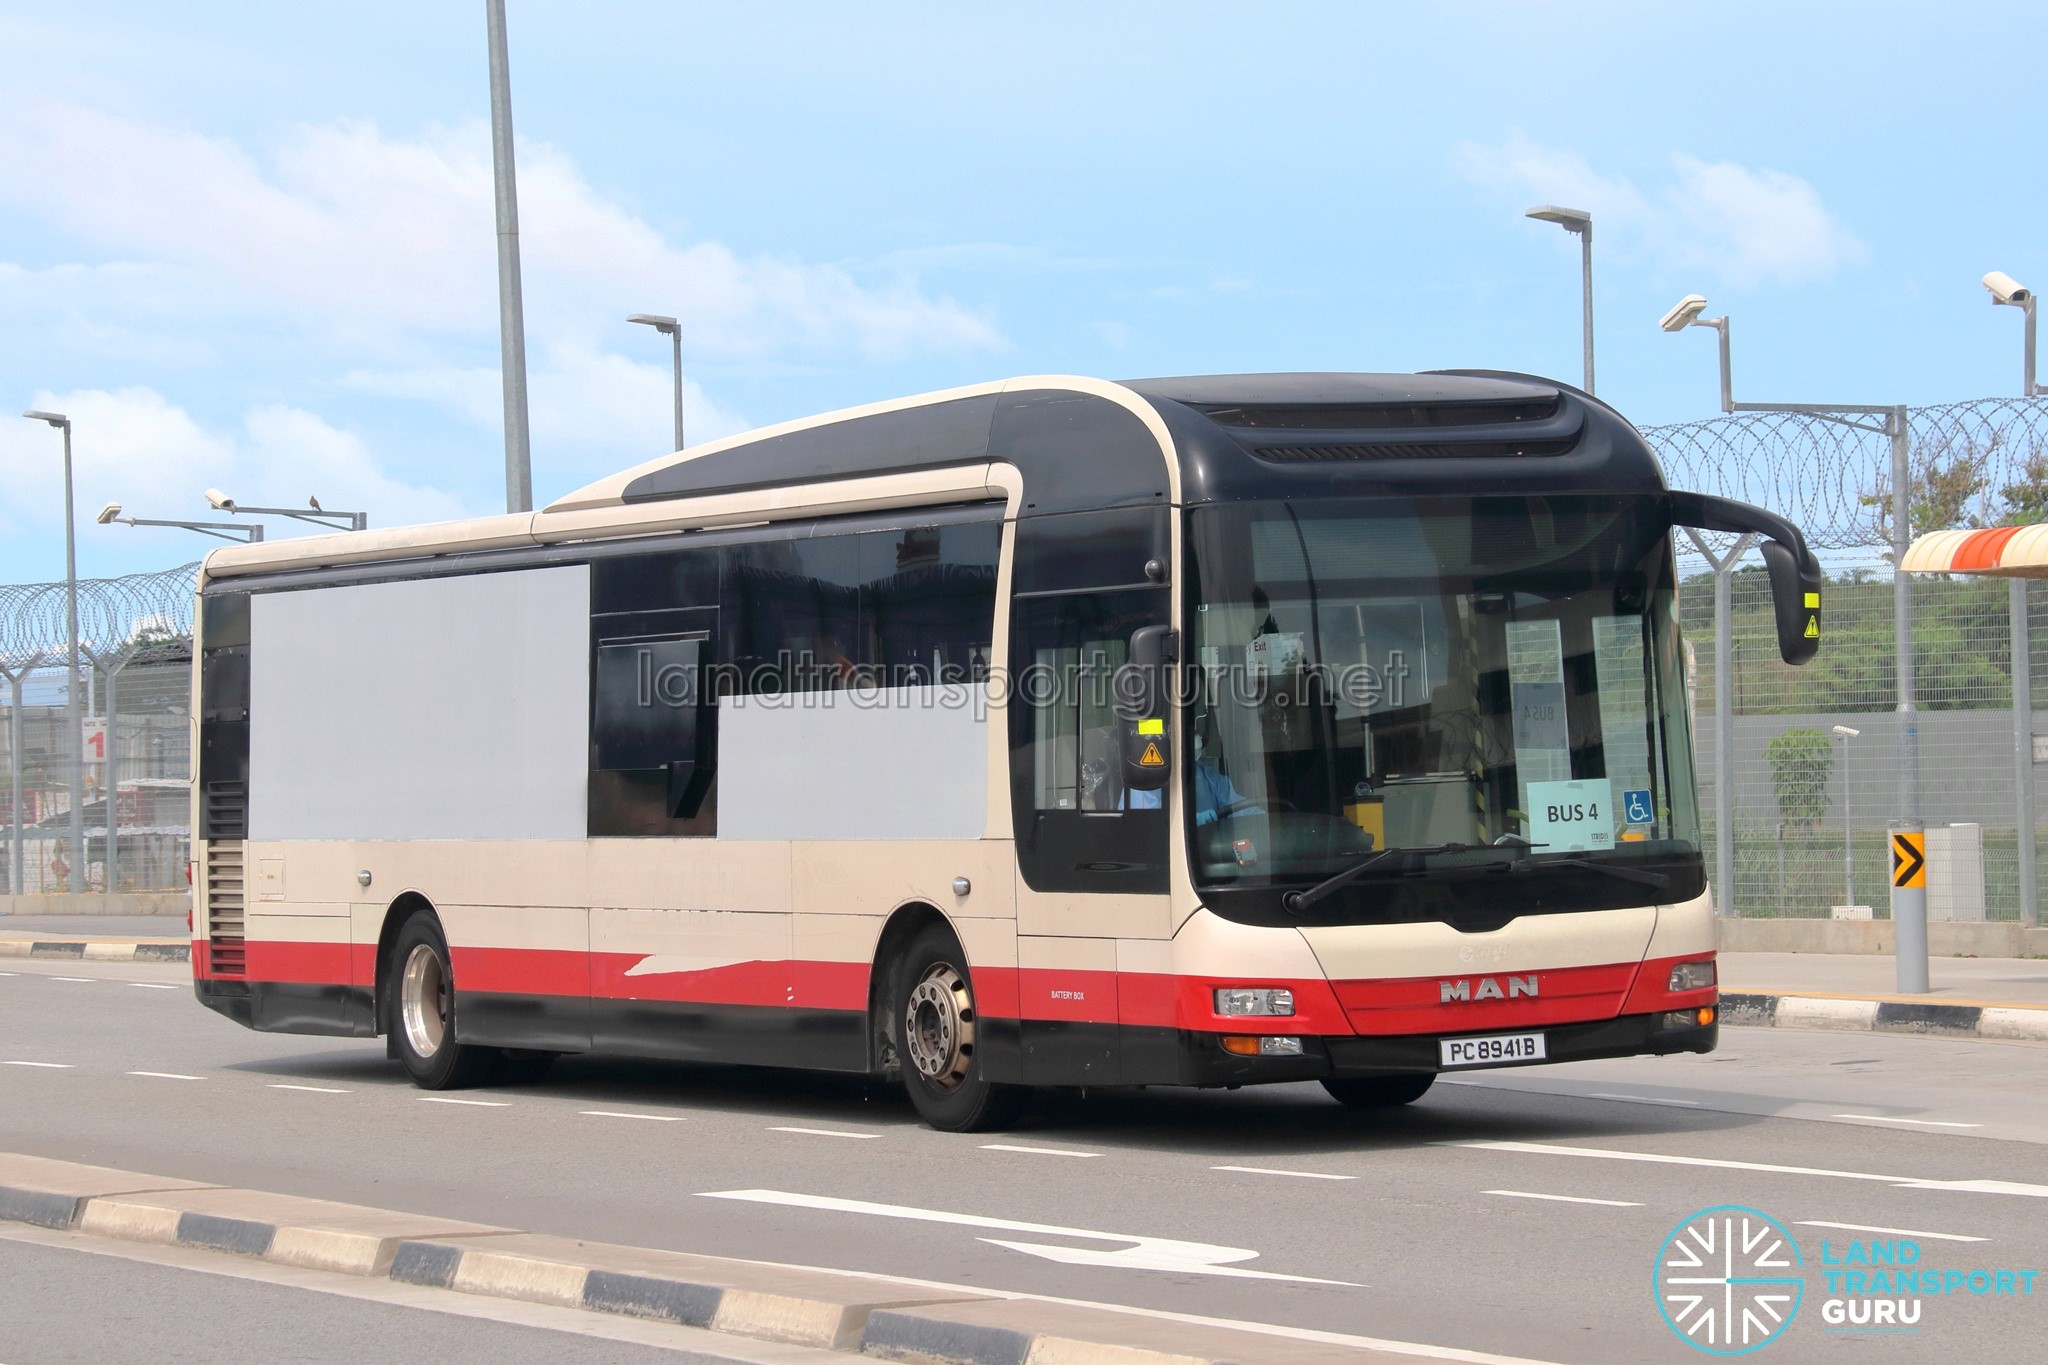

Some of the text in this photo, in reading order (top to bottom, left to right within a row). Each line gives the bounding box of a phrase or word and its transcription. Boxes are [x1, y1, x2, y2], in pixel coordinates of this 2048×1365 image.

[1254, 641, 1267, 651] Exit
[88, 731, 104, 757] 1
[1547, 803, 1599, 823] BUS 4
[1051, 990, 1084, 1000] BATTERY BOX
[1440, 975, 1539, 1003] MAN
[1450, 1037, 1536, 1062] PC8941B
